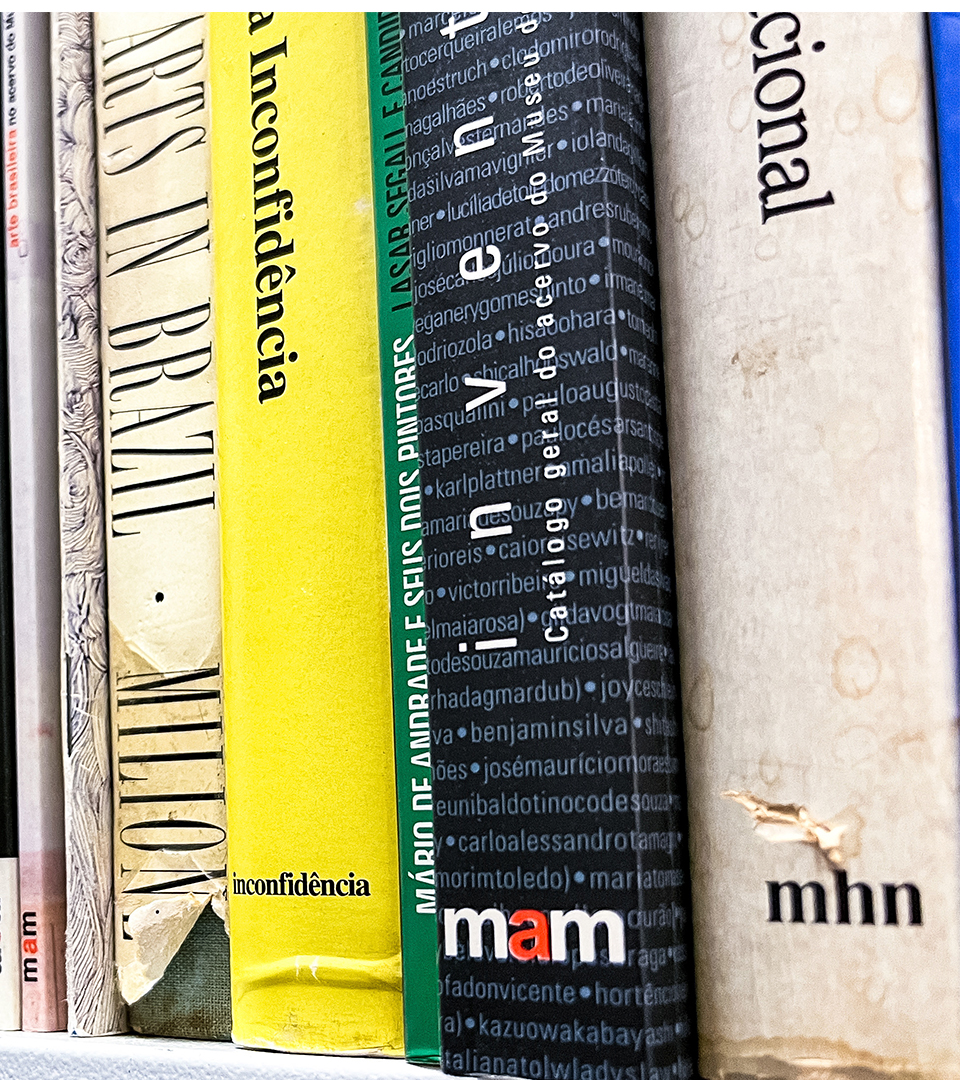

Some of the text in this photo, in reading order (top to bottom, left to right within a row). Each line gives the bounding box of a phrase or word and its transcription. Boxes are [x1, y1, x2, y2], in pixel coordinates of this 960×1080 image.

[6, 54, 20, 248] arte brasileira acervo
[102, 15, 215, 538] ARTS IN BRAZIL
[249, 36, 299, 405] Inconfidência
[522, 52, 570, 643] Catálogo geral do acervo do Museu
[384, 131, 437, 914] MÁRIO DE ANDRADE SEUS DOIS PINTORES LASAR SEGALL
[470, 712, 628, 746] benjaminsilva
[23, 911, 38, 983] mam
[232, 871, 371, 897] inconfidência
[442, 907, 627, 966] mam
[765, 869, 924, 927] mhn
